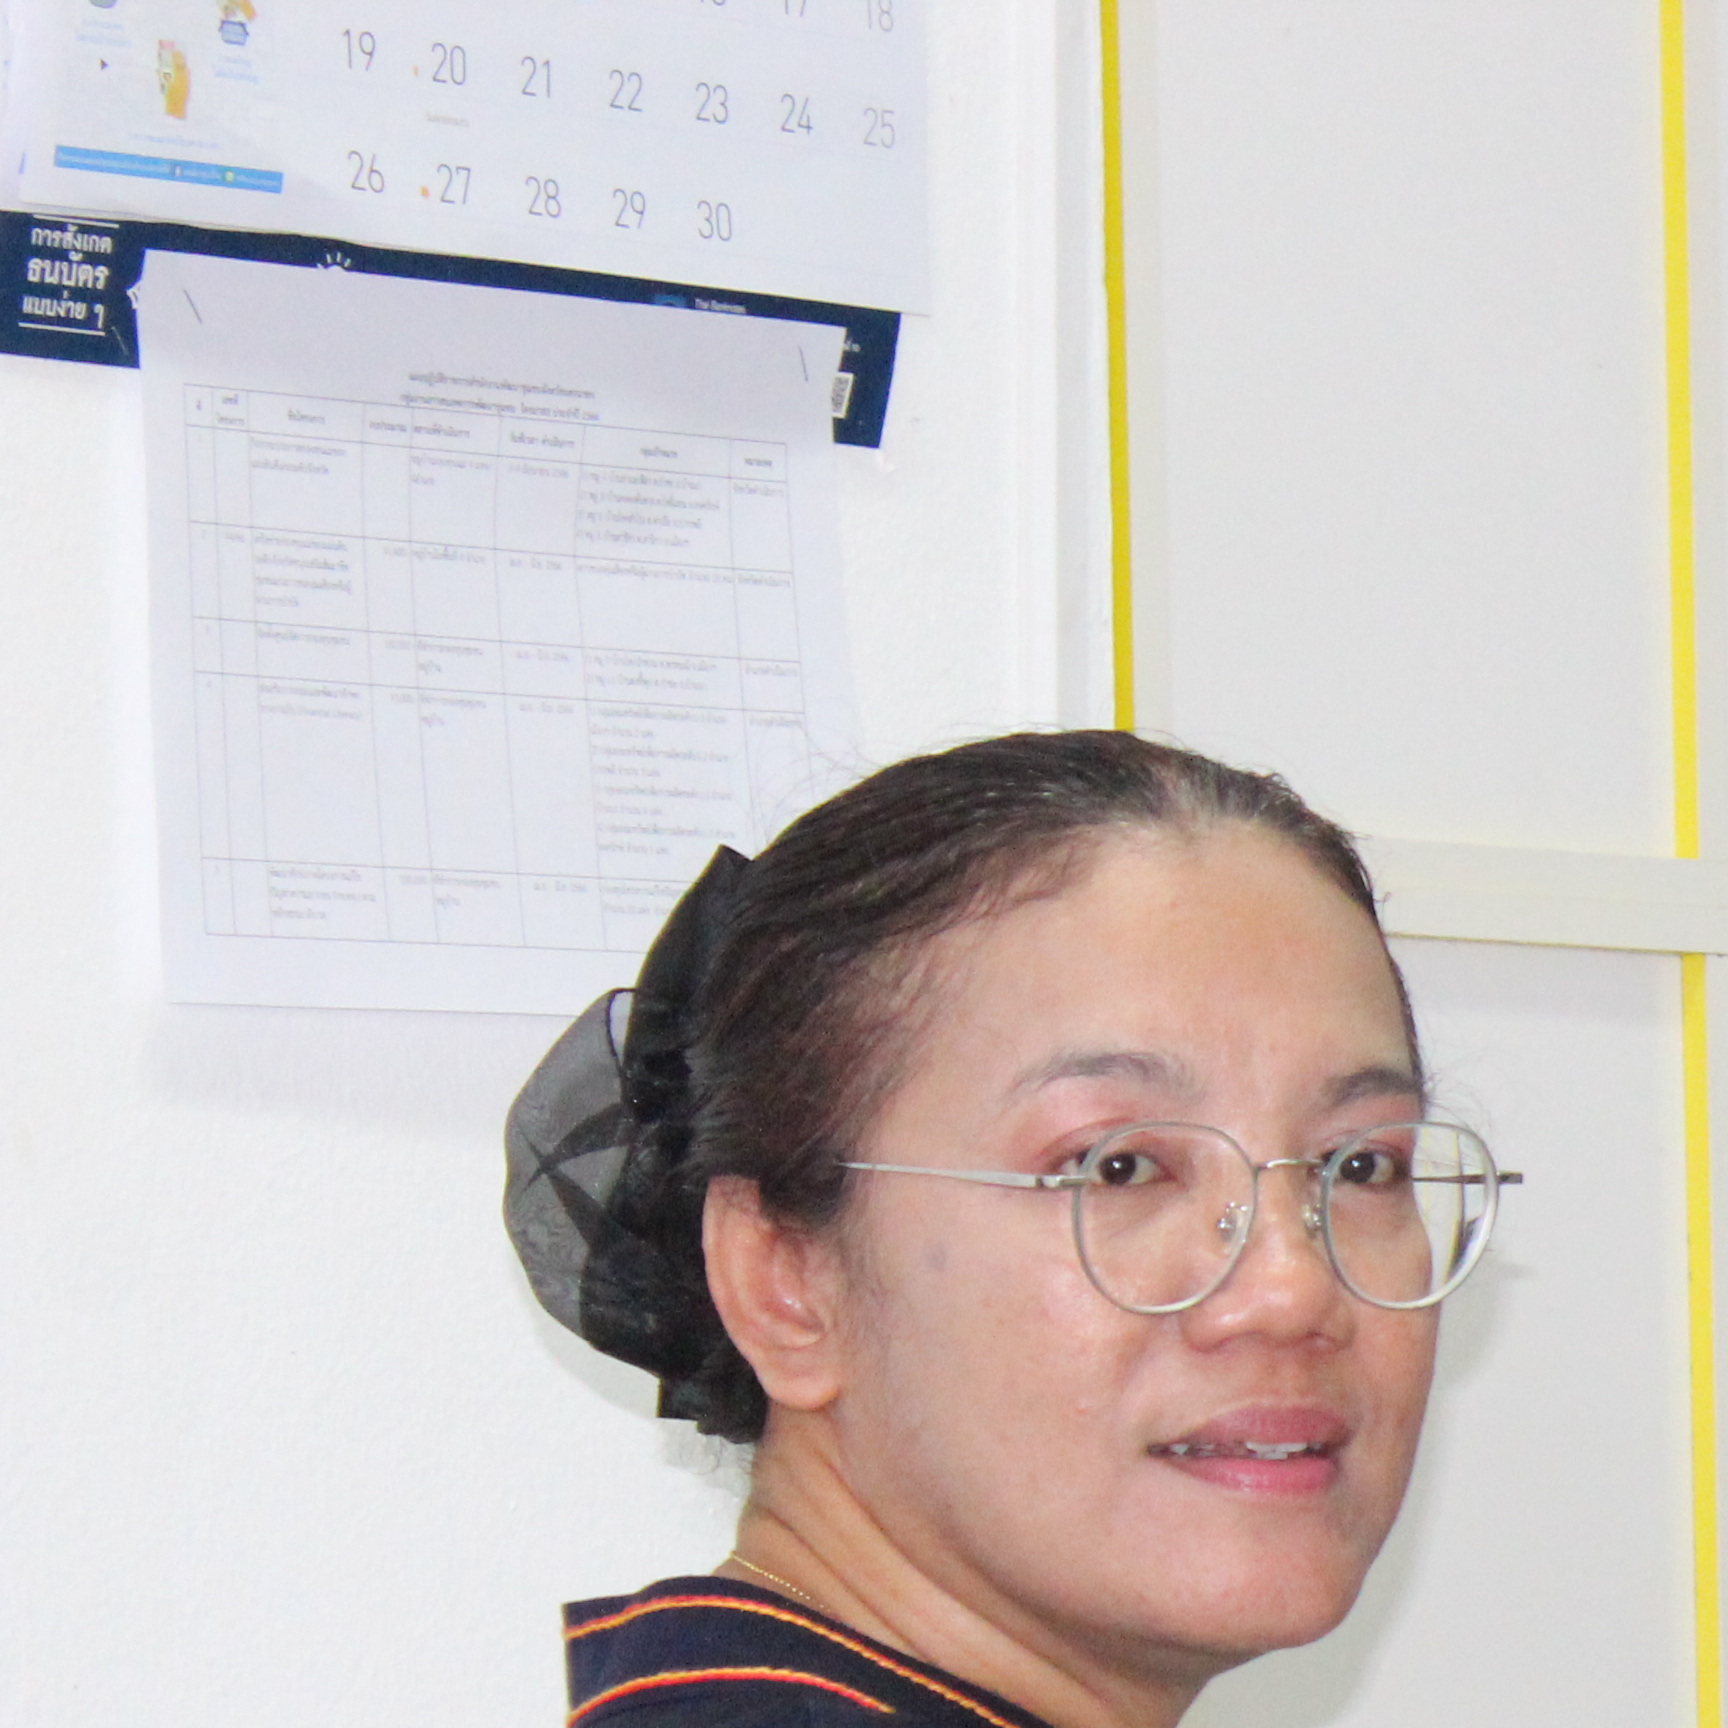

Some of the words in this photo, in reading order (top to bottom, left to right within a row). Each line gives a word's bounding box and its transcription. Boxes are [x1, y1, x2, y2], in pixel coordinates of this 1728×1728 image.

[343, 29, 377, 71] 19
[432, 43, 468, 86] 20
[521, 57, 552, 98] 21
[610, 69, 644, 113] 22
[696, 82, 730, 125] 23
[781, 94, 815, 135] 24
[864, 107, 896, 149] 25
[348, 151, 386, 194] 26
[438, 164, 472, 206] 27
[526, 177, 562, 219] 28
[614, 188, 647, 230] 29
[698, 200, 734, 243] 30
[31, 225, 113, 255] การสังเกต
[27, 250, 110, 290] ธนบัตร
[22, 290, 87, 321] แบบง่าย
